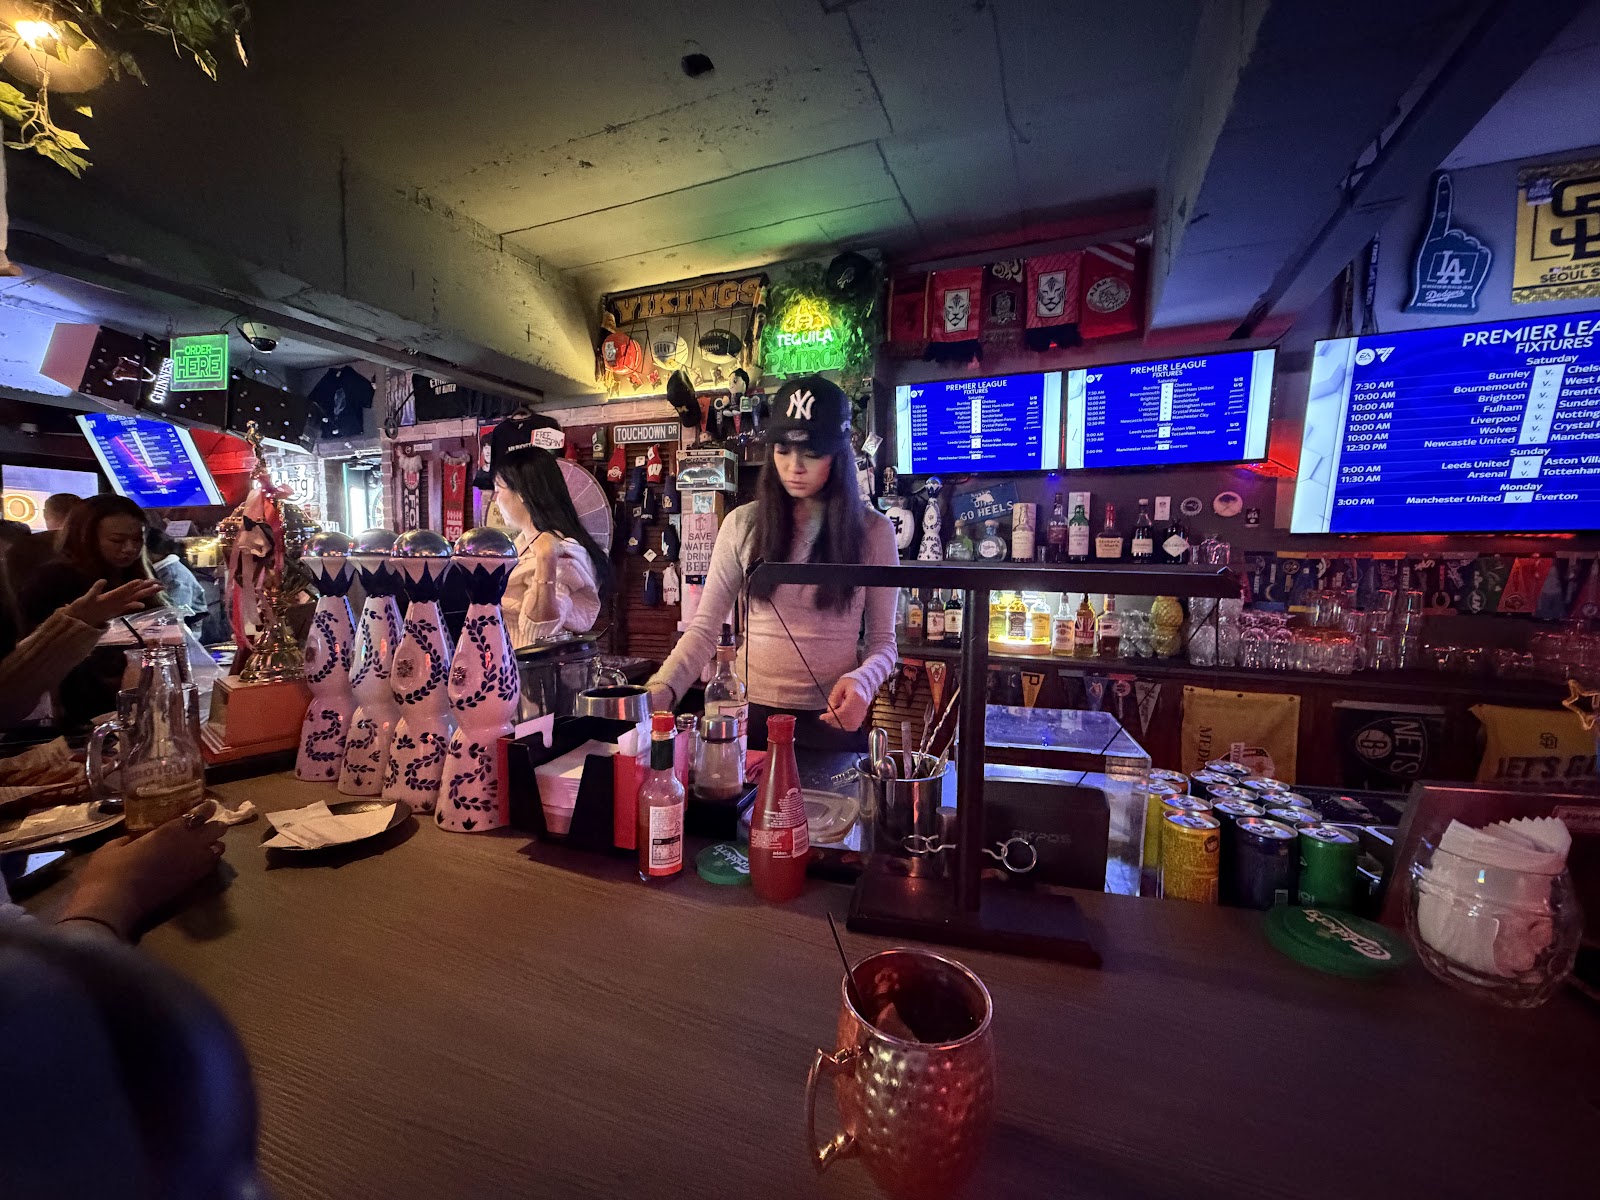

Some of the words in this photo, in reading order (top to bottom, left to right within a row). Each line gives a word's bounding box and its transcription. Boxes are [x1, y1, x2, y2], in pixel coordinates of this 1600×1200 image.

[1437, 250, 1466, 284] LA
[1540, 270, 1588, 283] SEOUL
[614, 278, 762, 323] VIKINGS
[1425, 290, 1465, 302] Dodgers
[776, 328, 833, 348] TEQUILA
[1462, 324, 1556, 347] PREMIER
[184, 344, 212, 355] ORDER
[1516, 337, 1593, 354] FIXTURES
[1526, 354, 1578, 365] Saturday
[176, 354, 221, 378] HERE
[1130, 364, 1168, 374] PREMIER
[1170, 360, 1207, 370] LEAGUE
[1152, 370, 1183, 378] FIXTURES
[1488, 370, 1530, 381] Burnley
[150, 358, 174, 404] GUINNESS
[946, 382, 976, 391] PREMIER
[978, 380, 1007, 388] LEAGUE
[1356, 382, 1376, 391] 7:30
[1378, 381, 1394, 389] AM
[1454, 381, 1527, 394] Bournemouth
[1565, 376, 1594, 385] West
[1354, 392, 1379, 401] 10:00
[1381, 391, 1395, 399] AM
[1478, 392, 1525, 404] Brighton
[786, 389, 815, 420] NY
[1352, 403, 1377, 411] 10:00
[1483, 404, 1522, 413] Fulham
[1351, 413, 1375, 421] 10:00
[1377, 412, 1392, 420] AM
[1470, 414, 1520, 425] Liverpool
[616, 426, 666, 441] TOUCHDOWN
[668, 425, 677, 435] DR
[1480, 425, 1517, 434] Wolves
[1553, 421, 1594, 432] Crystal
[536, 430, 552, 439] FREE
[1347, 434, 1372, 442] 10:00
[1346, 444, 1370, 452] 12:30
[1424, 437, 1476, 448] Newcastle
[1480, 436, 1515, 445] United
[1510, 447, 1550, 456] Sunday
[1365, 465, 1381, 473] AM
[1442, 461, 1472, 470] Leeds
[1474, 460, 1509, 468] United
[1544, 457, 1577, 465] Aston
[1341, 475, 1363, 483] 11:30
[1468, 470, 1507, 479] Arsenal
[1500, 482, 1542, 492] Monday
[1406, 495, 1464, 504] Manchester
[1466, 494, 1501, 502] United
[1535, 492, 1578, 501] Everton
[408, 494, 416, 527] FC
[960, 511, 974, 521] GO
[978, 501, 1014, 516] HEELS
[689, 532, 712, 540] SAVE
[686, 562, 710, 572] BEE
[1390, 720, 1423, 774] NETS
[1496, 756, 1560, 778] LET'S
